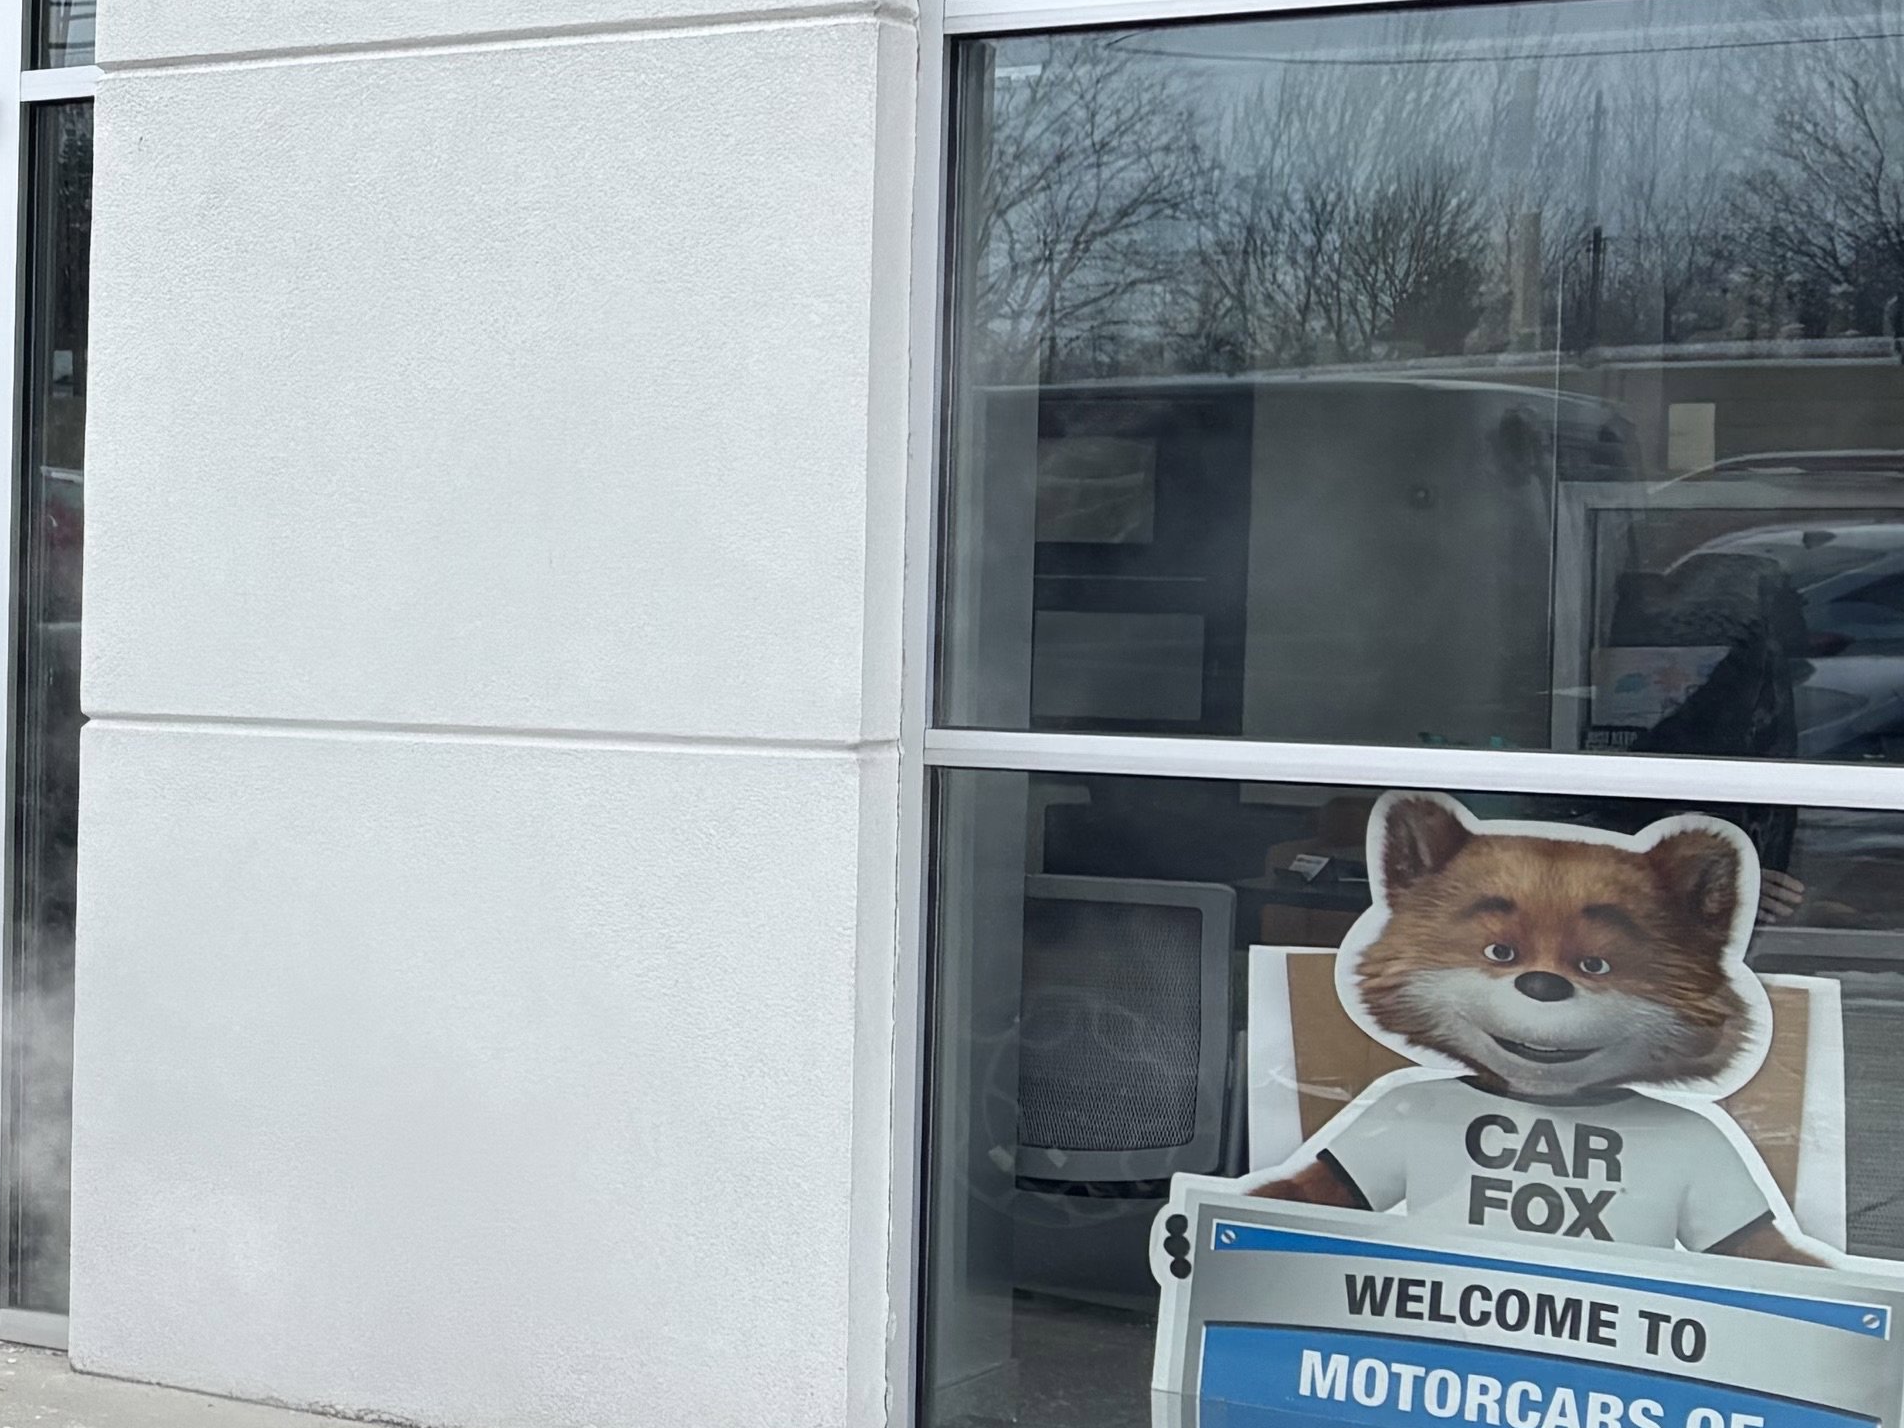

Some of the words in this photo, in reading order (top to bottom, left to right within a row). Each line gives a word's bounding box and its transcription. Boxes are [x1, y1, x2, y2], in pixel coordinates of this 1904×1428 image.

[1464, 1113, 1624, 1183] CAR
[1468, 1174, 1617, 1243] FOX
[1345, 1273, 1620, 1348] WELCOME
[1638, 1309, 1707, 1364] TO
